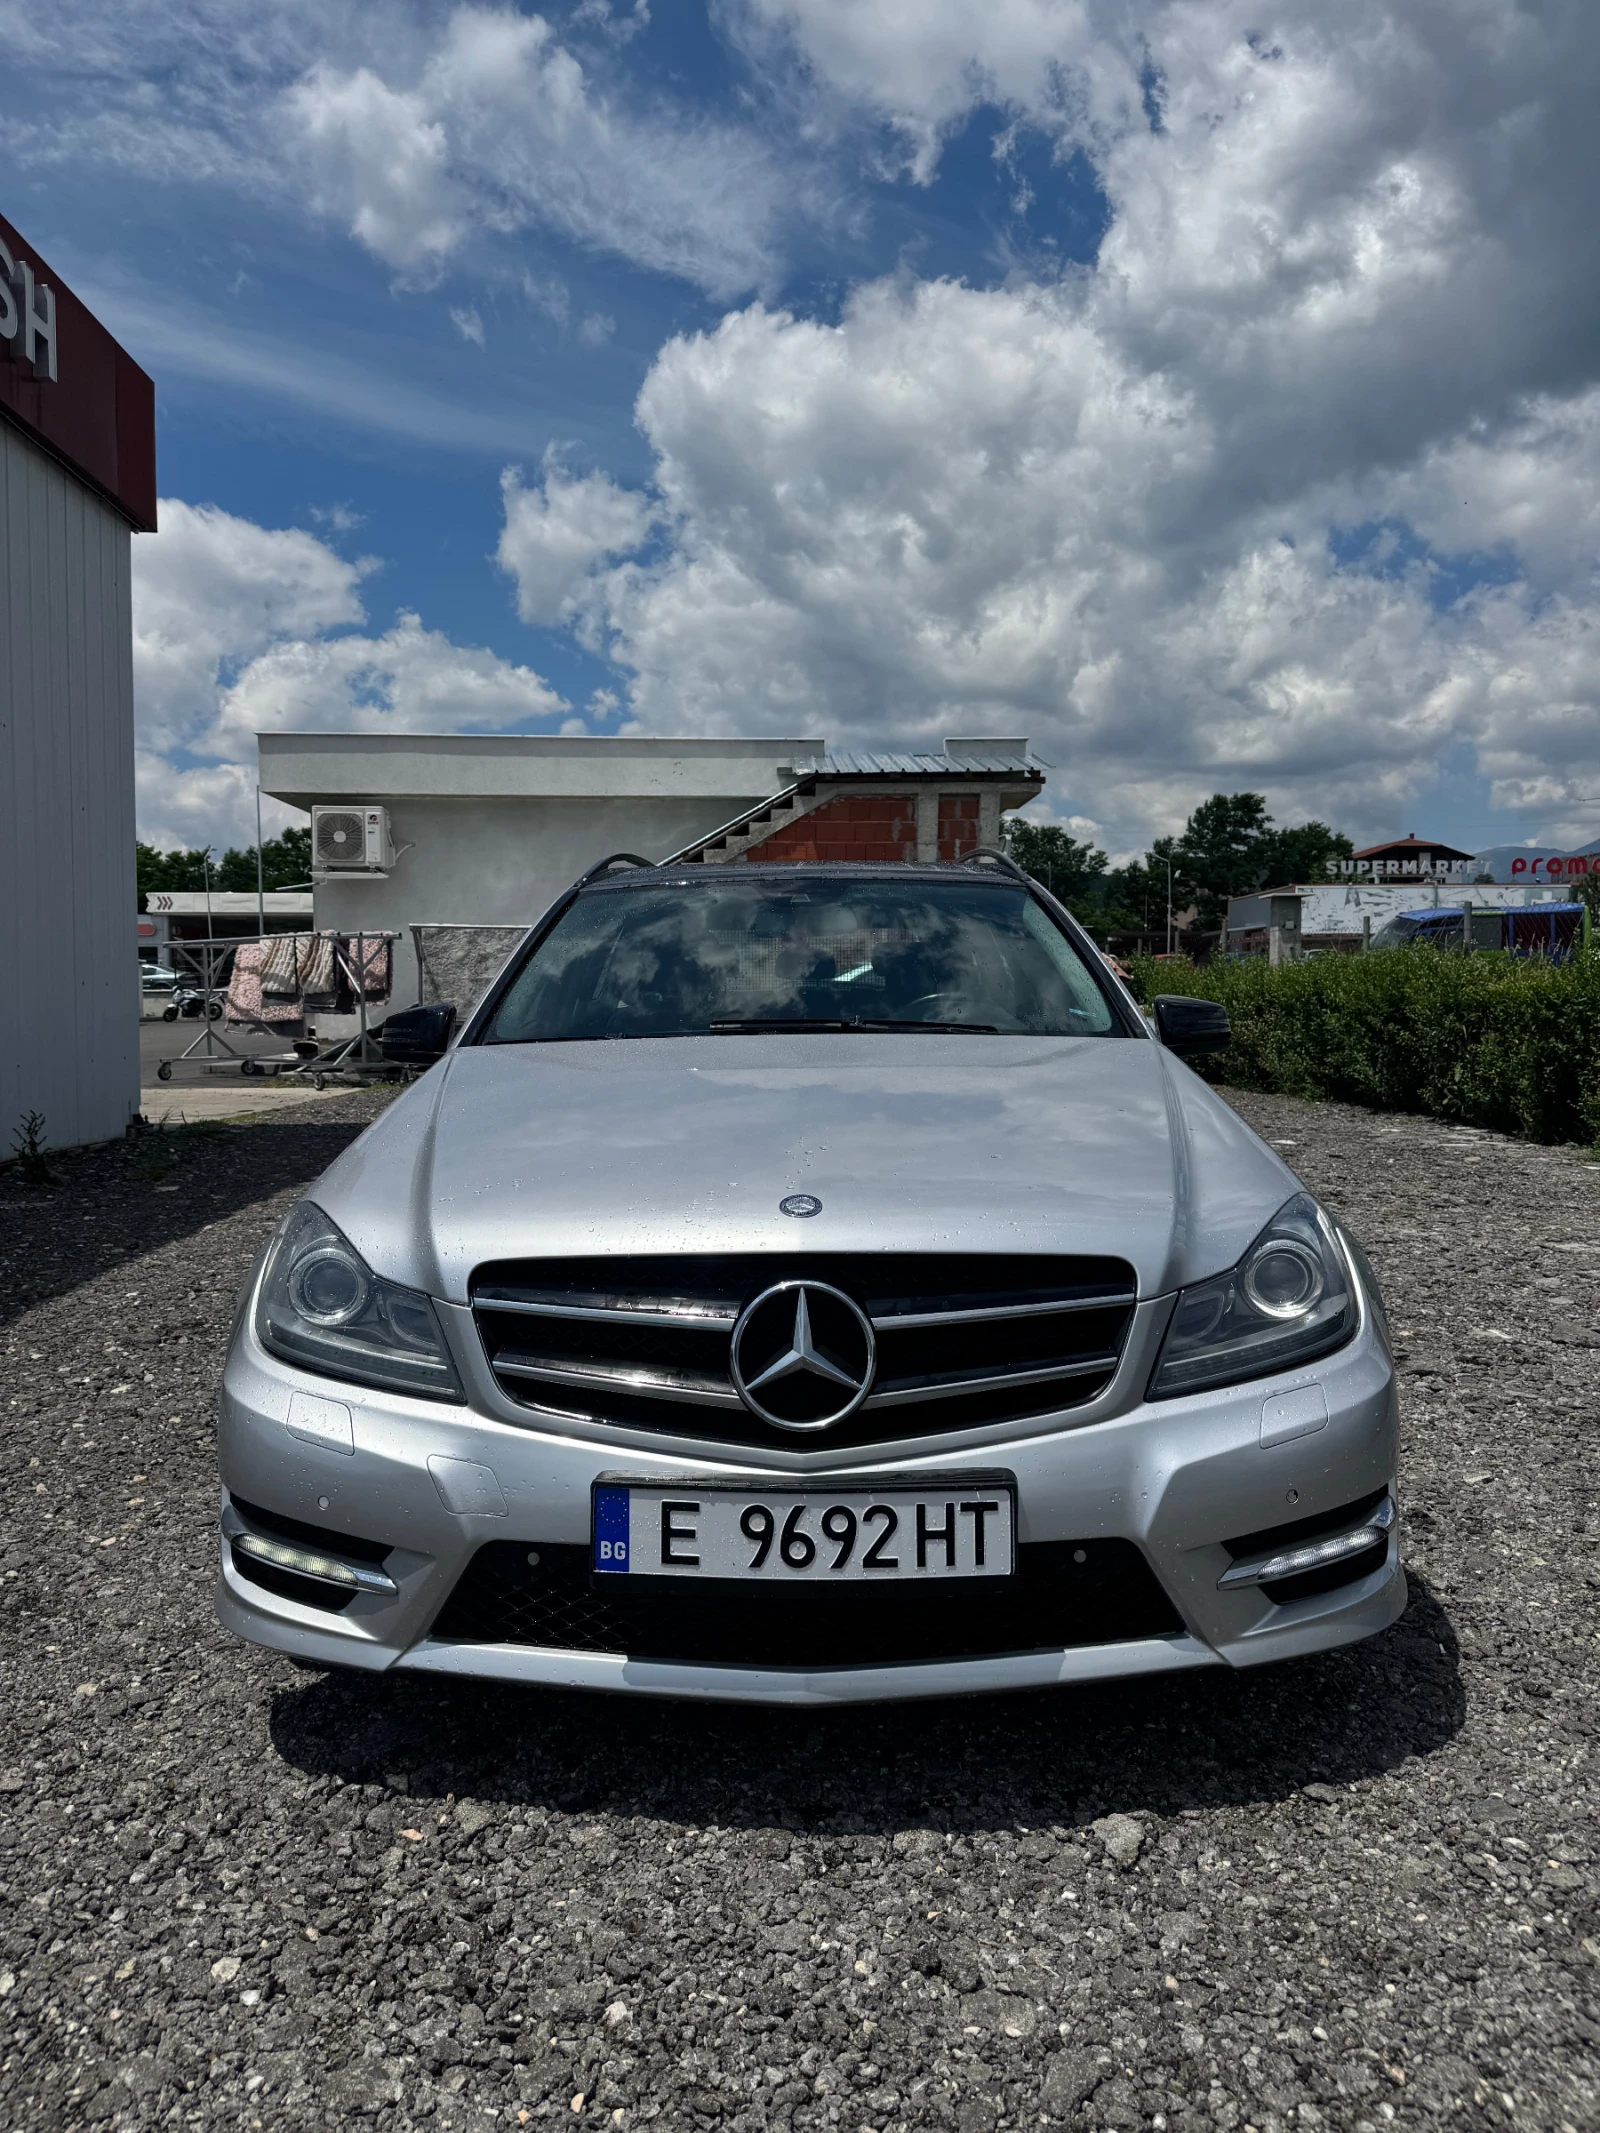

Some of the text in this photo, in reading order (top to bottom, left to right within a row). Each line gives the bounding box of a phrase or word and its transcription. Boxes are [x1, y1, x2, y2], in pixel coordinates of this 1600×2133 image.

[1325, 859, 1493, 875] SUPERMARKET
[661, 1500, 700, 1566] E
[600, 1540, 626, 1560] BG
